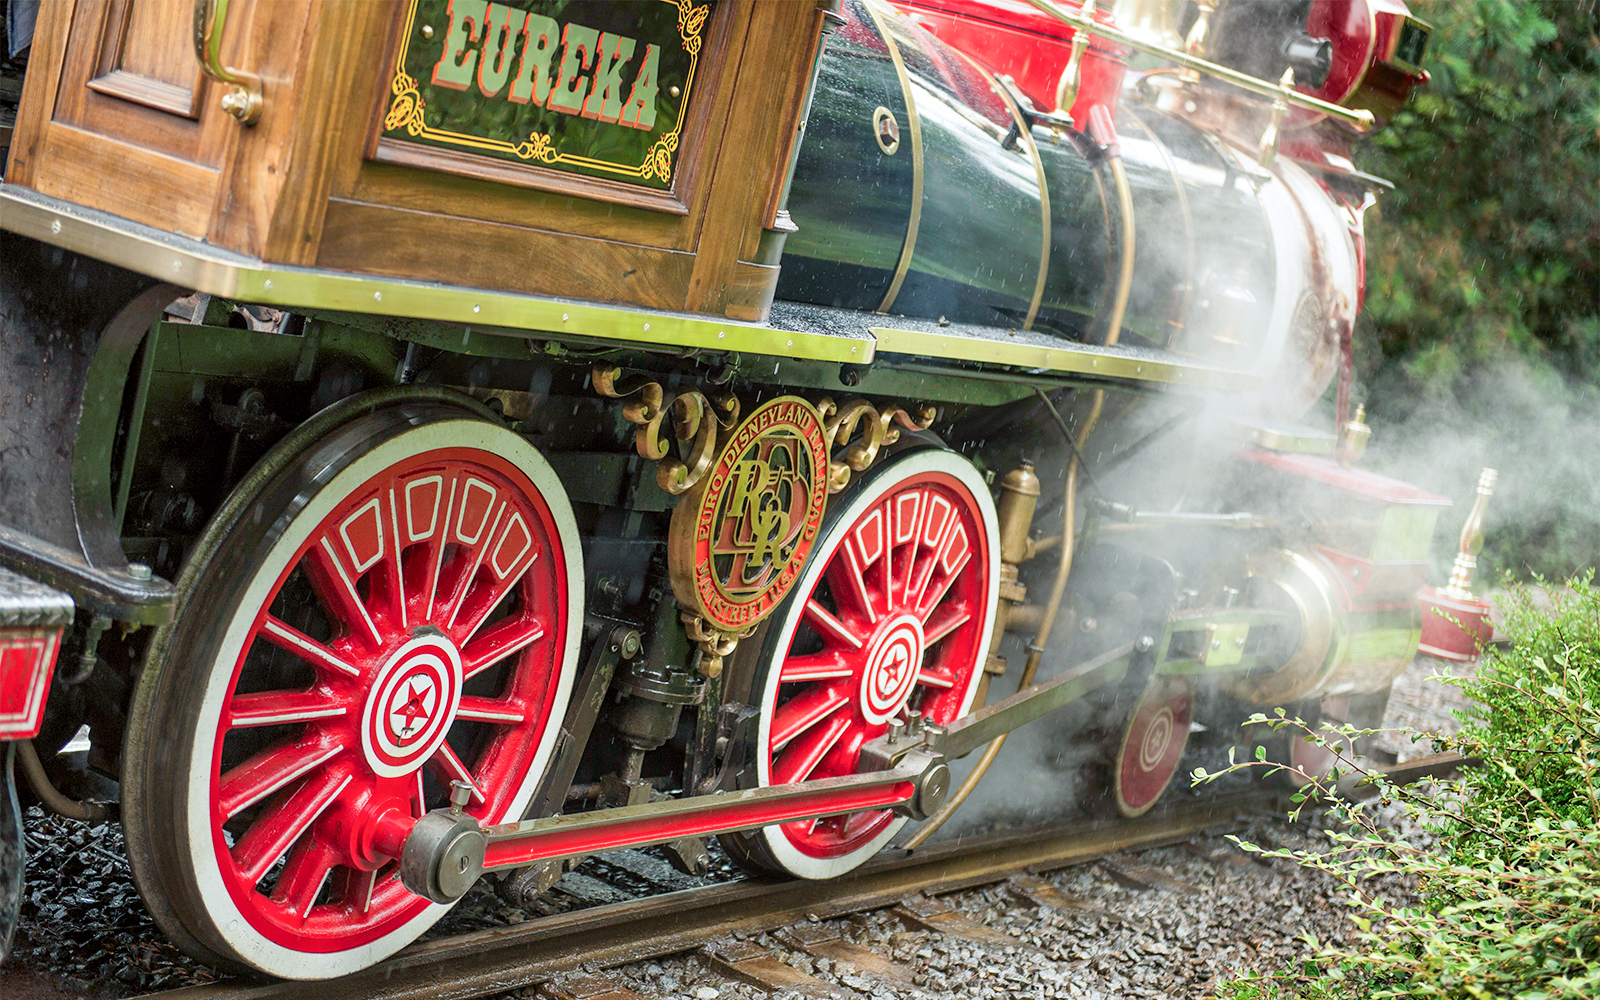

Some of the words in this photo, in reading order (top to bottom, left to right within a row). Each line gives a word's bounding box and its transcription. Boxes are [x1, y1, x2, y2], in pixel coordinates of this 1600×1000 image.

[431, 0, 660, 132] EUREKA
[698, 474, 723, 541] EURO
[723, 404, 812, 466] DISNEYLAND
[805, 430, 824, 541] RAILROAD
